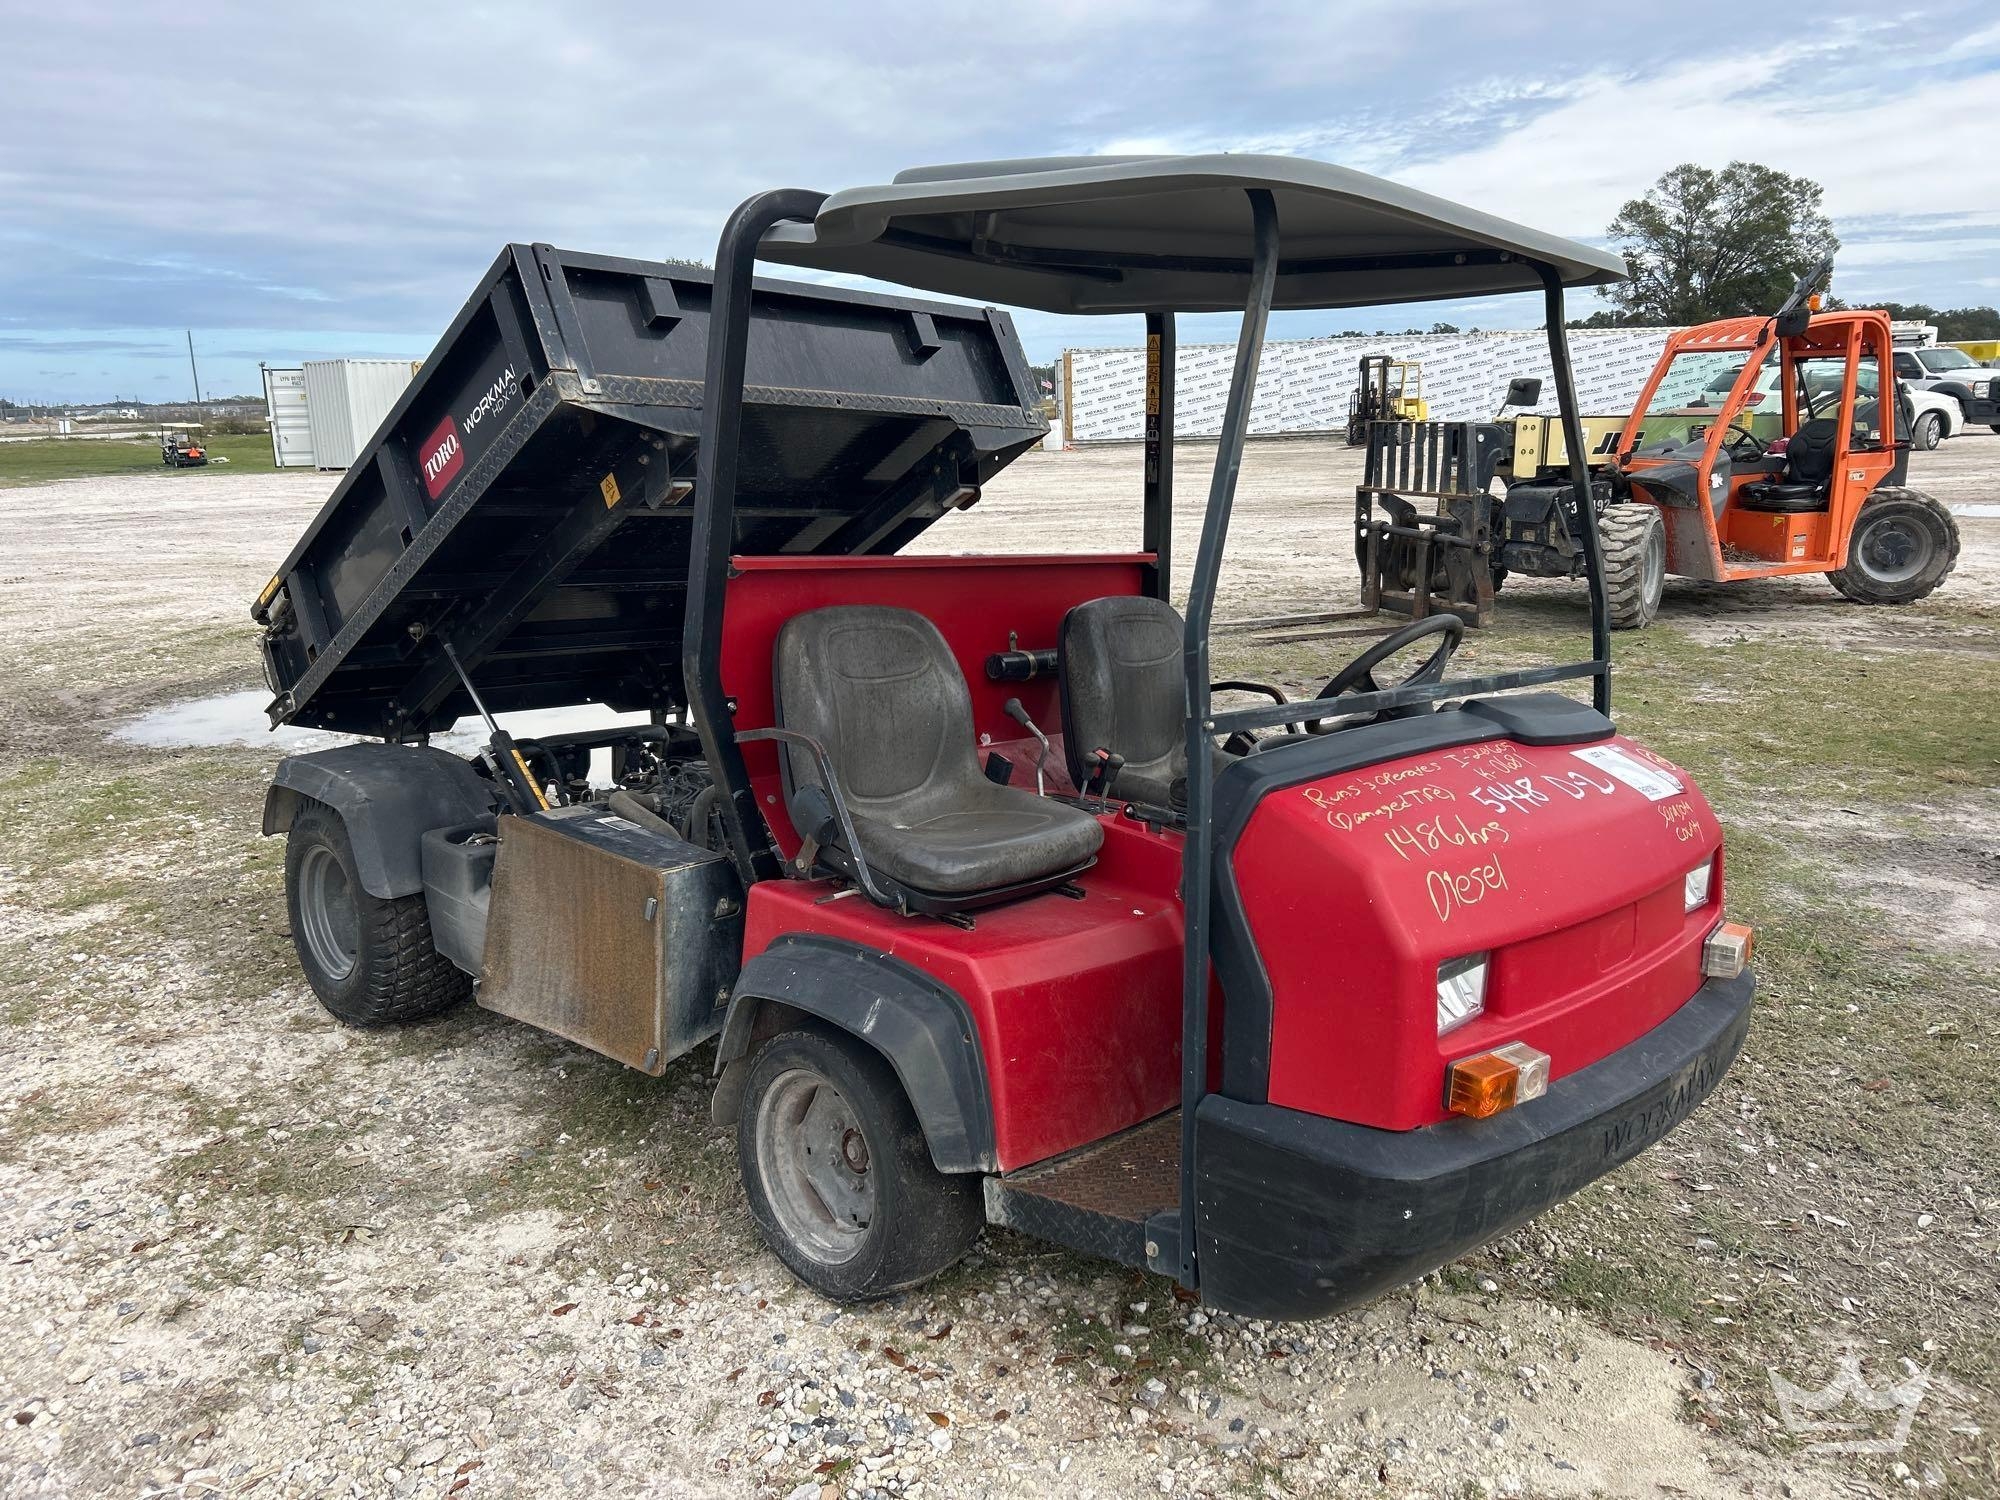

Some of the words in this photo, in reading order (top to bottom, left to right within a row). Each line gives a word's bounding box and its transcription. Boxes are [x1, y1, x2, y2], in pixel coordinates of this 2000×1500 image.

[425, 434, 457, 482] TORO
[1302, 784, 1361, 809] Runs
[1469, 777, 1549, 814] 5448
